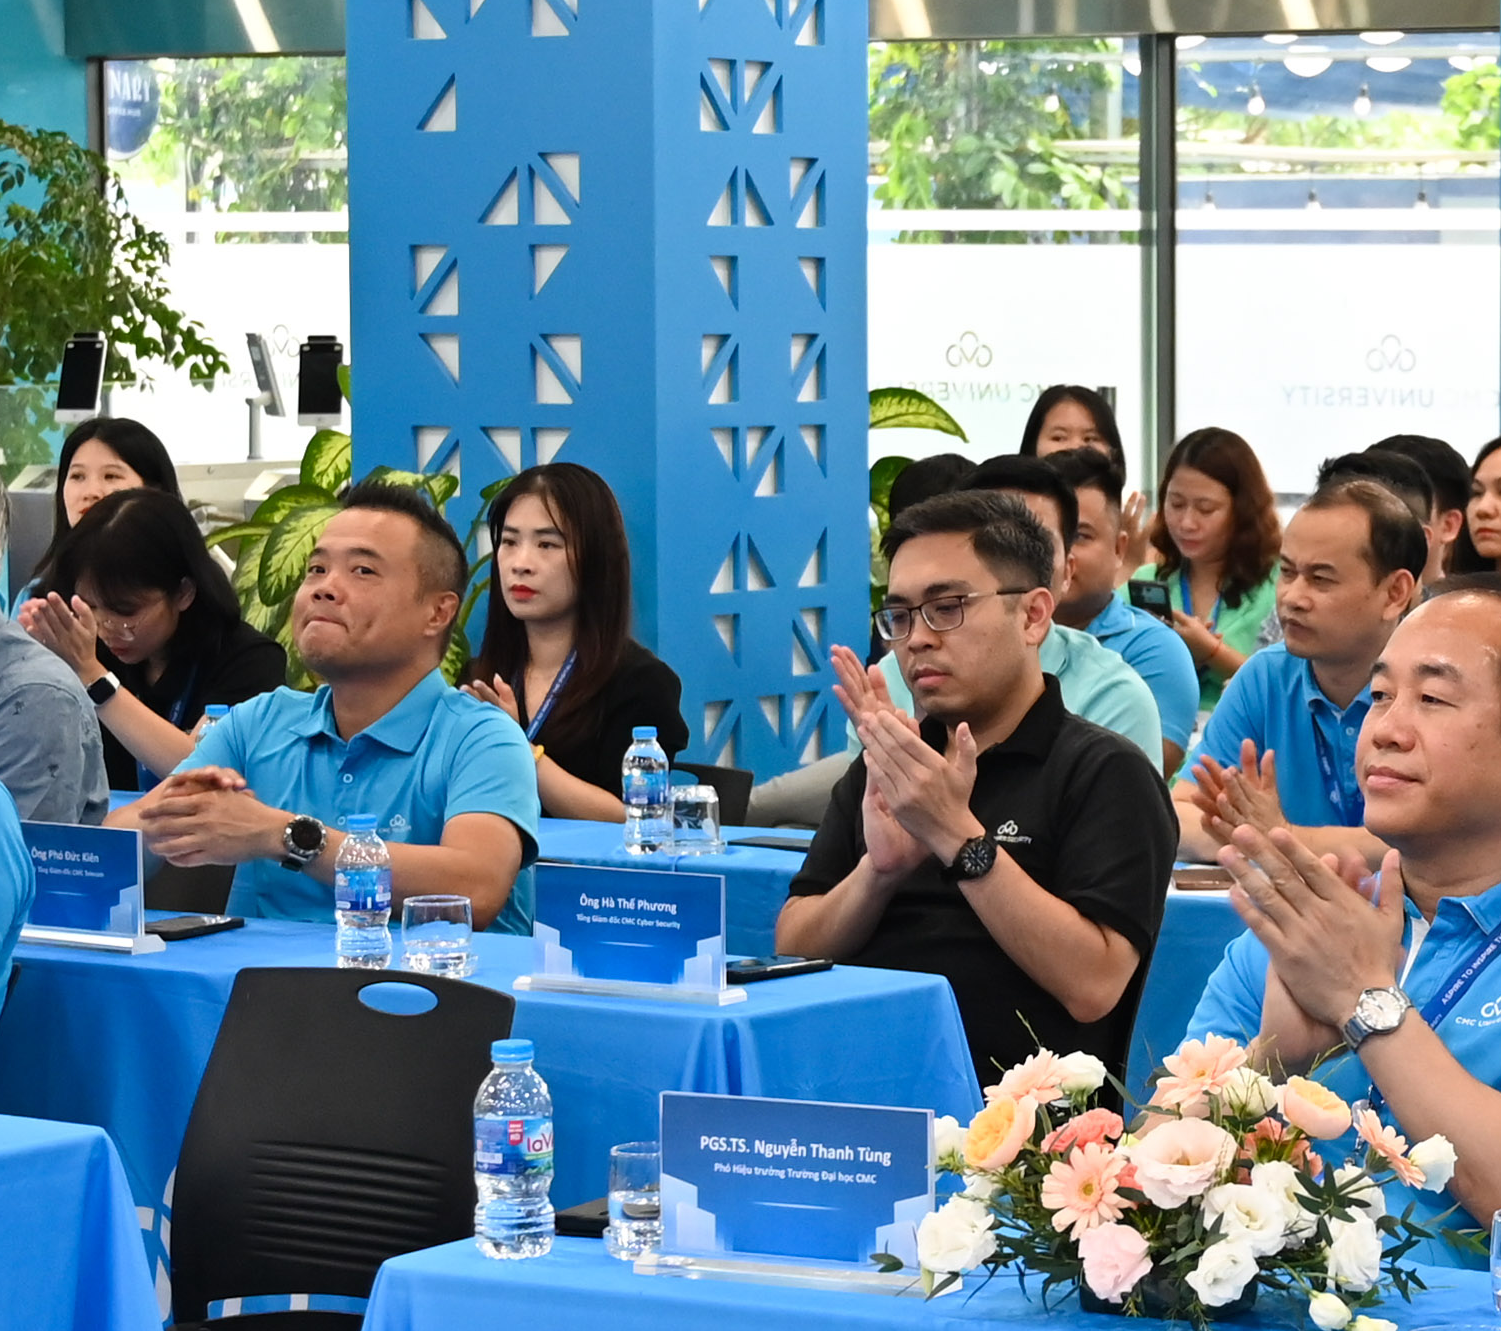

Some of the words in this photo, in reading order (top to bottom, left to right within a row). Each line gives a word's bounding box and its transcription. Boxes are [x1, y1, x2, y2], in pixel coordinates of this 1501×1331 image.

[580, 893, 600, 909] Ông
[601, 896, 615, 908] Hà
[617, 897, 636, 910] Thế
[637, 899, 677, 915] Phương
[1441, 978, 1465, 1005] ASPIRE
[1461, 968, 1474, 980] TO
[700, 1135, 750, 1154] PGS.TS.
[754, 1138, 807, 1160] Nguyễn
[810, 1143, 854, 1161] Thanh
[857, 1146, 892, 1167] Tùng
[714, 1163, 731, 1174] Phó
[732, 1163, 753, 1176] Hiệu
[787, 1168, 820, 1182] Trường
[821, 1170, 837, 1183] Đại
[838, 1172, 855, 1184] học
[856, 1173, 878, 1184] CMC
